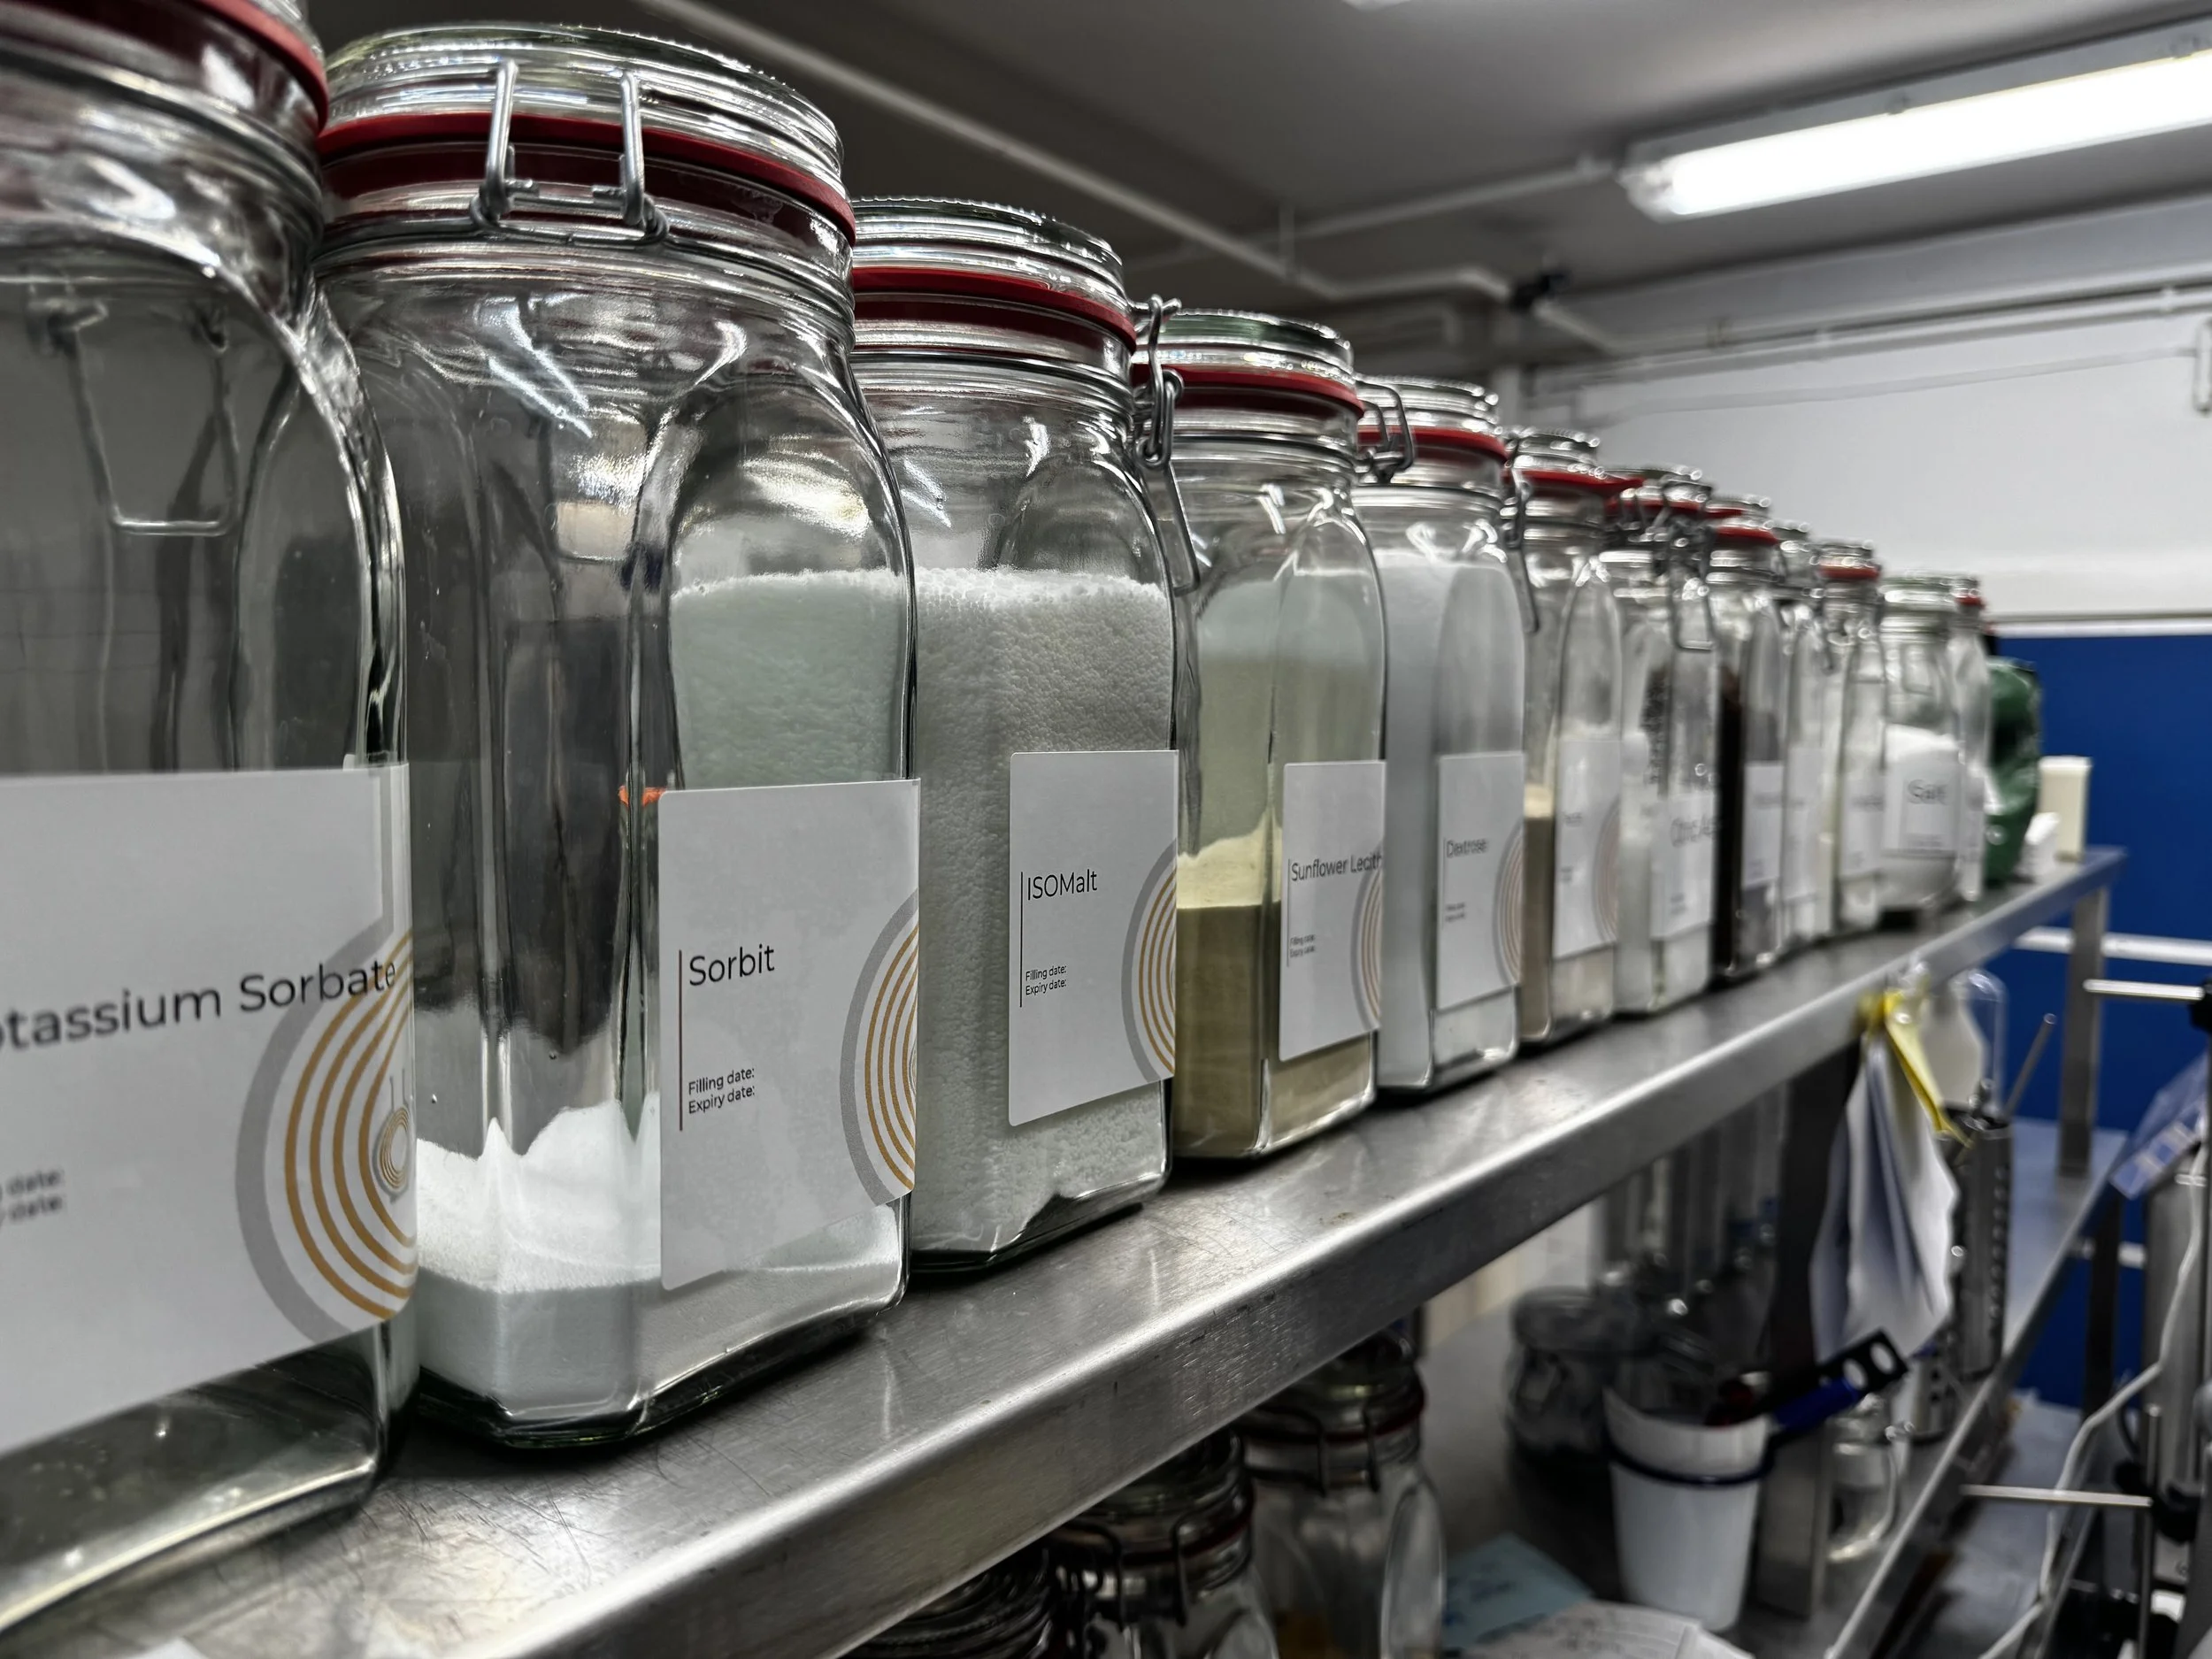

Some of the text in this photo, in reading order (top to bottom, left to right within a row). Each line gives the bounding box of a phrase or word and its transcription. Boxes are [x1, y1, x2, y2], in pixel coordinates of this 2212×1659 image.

[1291, 856, 1348, 881] Sunflower
[1026, 869, 1097, 901] ISOMalt
[688, 943, 775, 987] Sorbit
[1025, 965, 1067, 981] Filling date:
[240, 960, 396, 1014] Sorbate
[1025, 979, 1067, 995] Expiry date:
[688, 1067, 755, 1095] Filling date:
[688, 1086, 756, 1114] Expiry date:
